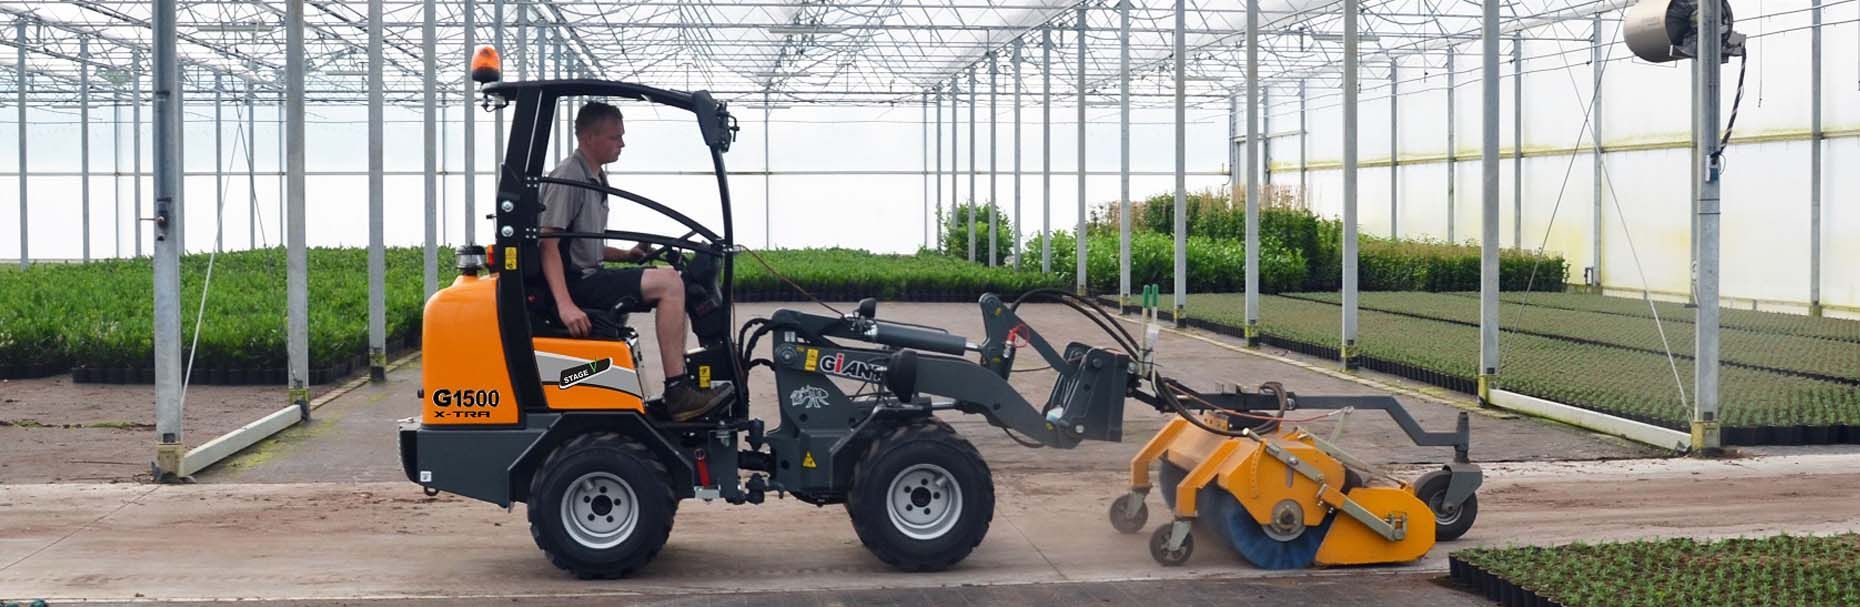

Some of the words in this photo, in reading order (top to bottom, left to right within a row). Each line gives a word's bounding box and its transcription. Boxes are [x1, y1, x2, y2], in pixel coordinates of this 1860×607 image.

[563, 369, 589, 383] STAGE
[432, 388, 500, 408] G1500
[434, 410, 491, 418] X-TRA
